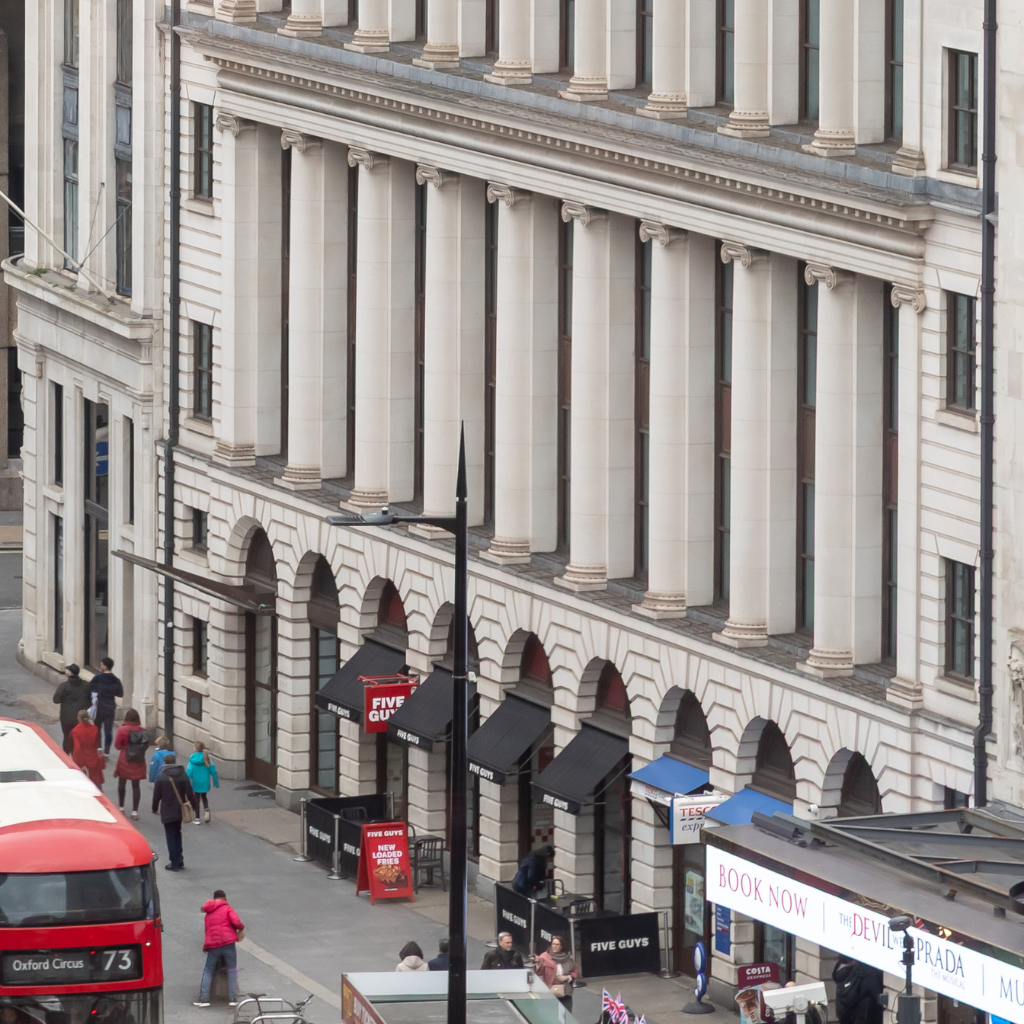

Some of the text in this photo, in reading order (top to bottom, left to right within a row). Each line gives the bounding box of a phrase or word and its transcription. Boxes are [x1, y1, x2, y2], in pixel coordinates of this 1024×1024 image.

[372, 695, 405, 709] FIVE
[397, 729, 420, 744] FIVE GUYS
[309, 825, 320, 838] FIVE
[383, 829, 403, 837] GUYS
[343, 843, 356, 856] FIVE
[372, 850, 403, 859] LOADED
[377, 857, 400, 865] FRIES
[719, 863, 763, 904] BOOK
[769, 884, 808, 919] NOW
[502, 909, 527, 929] FIVE GUYS
[540, 929, 552, 942] FIVE
[839, 912, 853, 928] THE
[852, 912, 894, 951] DEVIL
[590, 937, 649, 952] FIVE GUYS
[12, 949, 132, 971] Oxford Circus 73
[917, 937, 965, 978] PRADA
[745, 966, 771, 975] COSTA
[930, 968, 965, 990] THE MUSICAL
